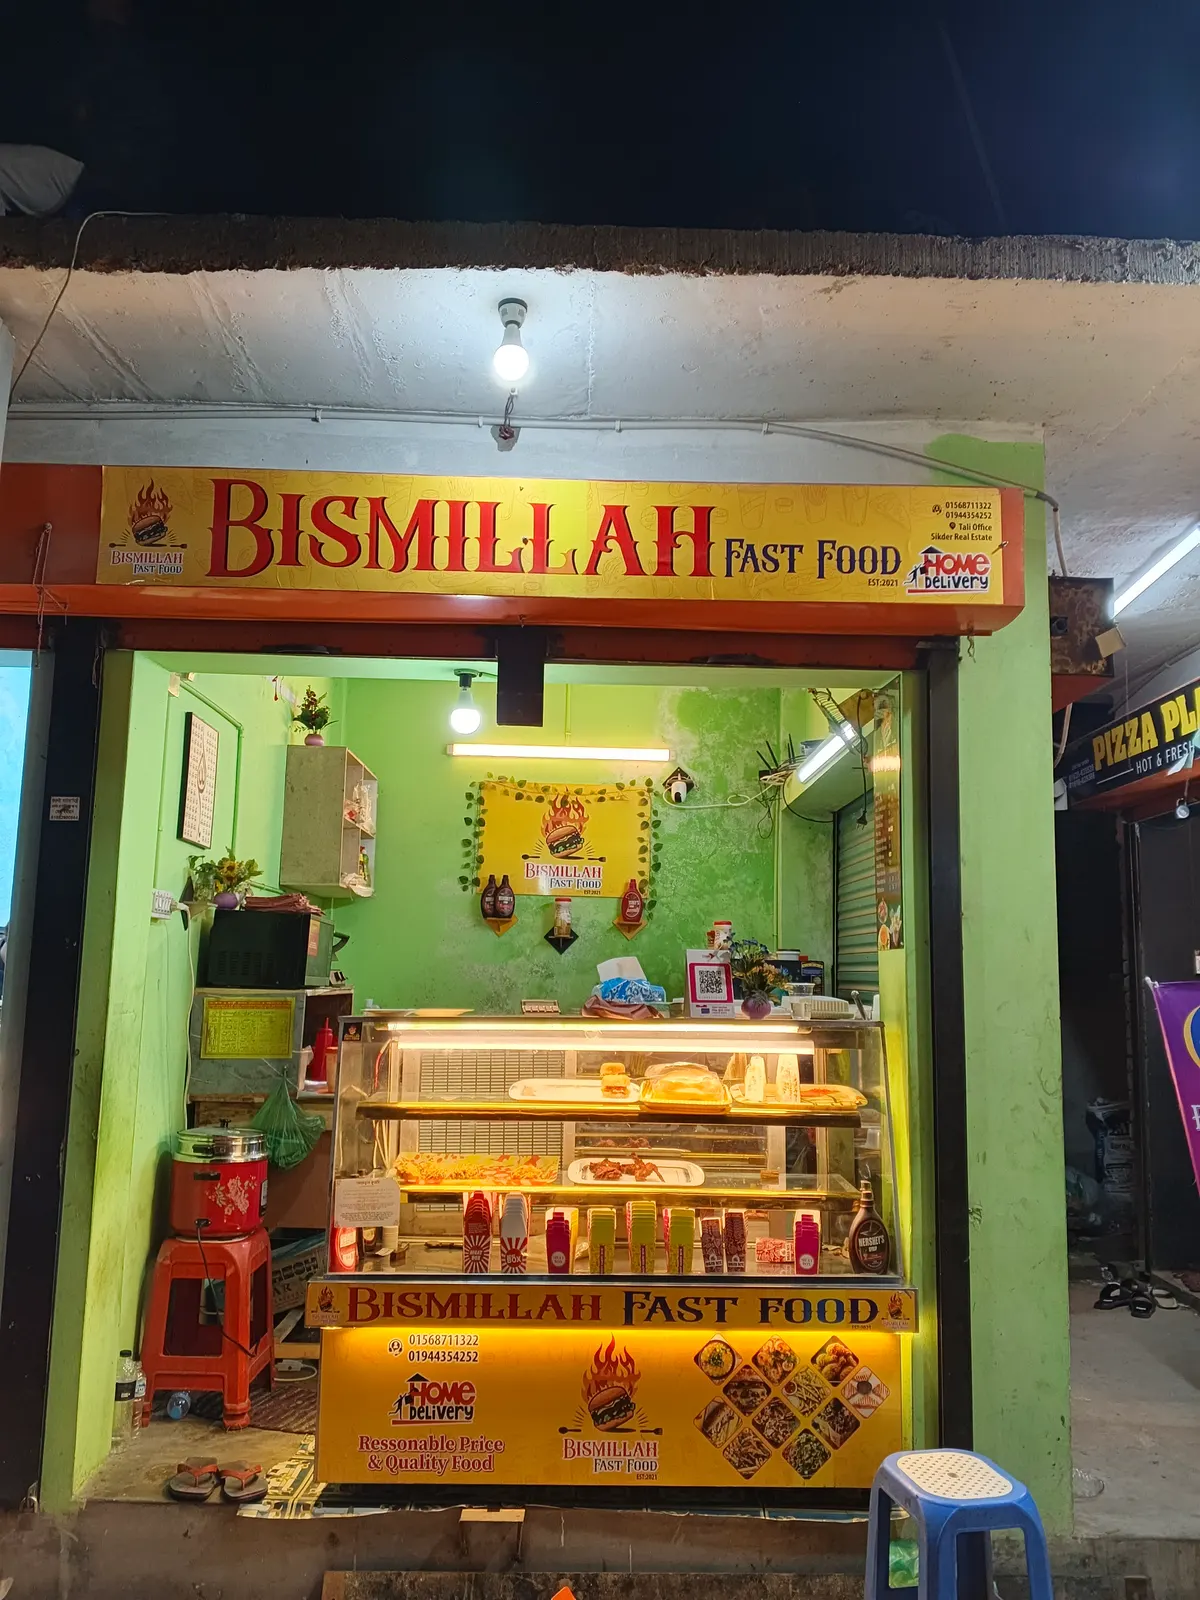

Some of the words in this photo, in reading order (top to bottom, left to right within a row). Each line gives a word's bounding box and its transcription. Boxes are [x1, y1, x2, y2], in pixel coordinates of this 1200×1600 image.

[945, 501, 992, 510] 01568711322
[945, 511, 992, 520] 01944354252
[205, 478, 716, 577] BISMILLAH
[725, 538, 804, 578] FAST
[816, 539, 902, 579] FOOD
[959, 523, 971, 531] Tali
[972, 523, 993, 531] Office
[930, 532, 953, 541] Sikder
[954, 532, 970, 541] Real
[971, 532, 993, 541] Estate
[111, 550, 184, 565] BISMILLAH
[133, 563, 156, 574] FAST
[158, 563, 183, 574] FOOD
[868, 578, 898, 587] EST:2021
[1092, 711, 1159, 772] PIZZA
[1136, 756, 1153, 774] HOT
[1156, 752, 1162, 767] &
[1165, 740, 1195, 763] FRESH
[525, 863, 602, 879] BISMILLAH
[550, 879, 574, 889] FAST
[576, 879, 602, 890] FOOD
[858, 1235, 885, 1247] HERSHEY'S
[346, 1286, 602, 1323] BISMILLAH
[623, 1291, 738, 1326] FAST
[758, 1298, 880, 1324] FOOD
[408, 1334, 479, 1347] 01568711322
[408, 1350, 479, 1363] 01944354252
[358, 1435, 456, 1453] Ressonable
[459, 1436, 505, 1453] Price
[562, 1438, 658, 1459] BISMILLAH
[367, 1455, 381, 1470] &
[385, 1454, 449, 1476] Quality
[451, 1455, 495, 1473] Food
[593, 1459, 622, 1473] FAST
[627, 1459, 658, 1473] FOOD
